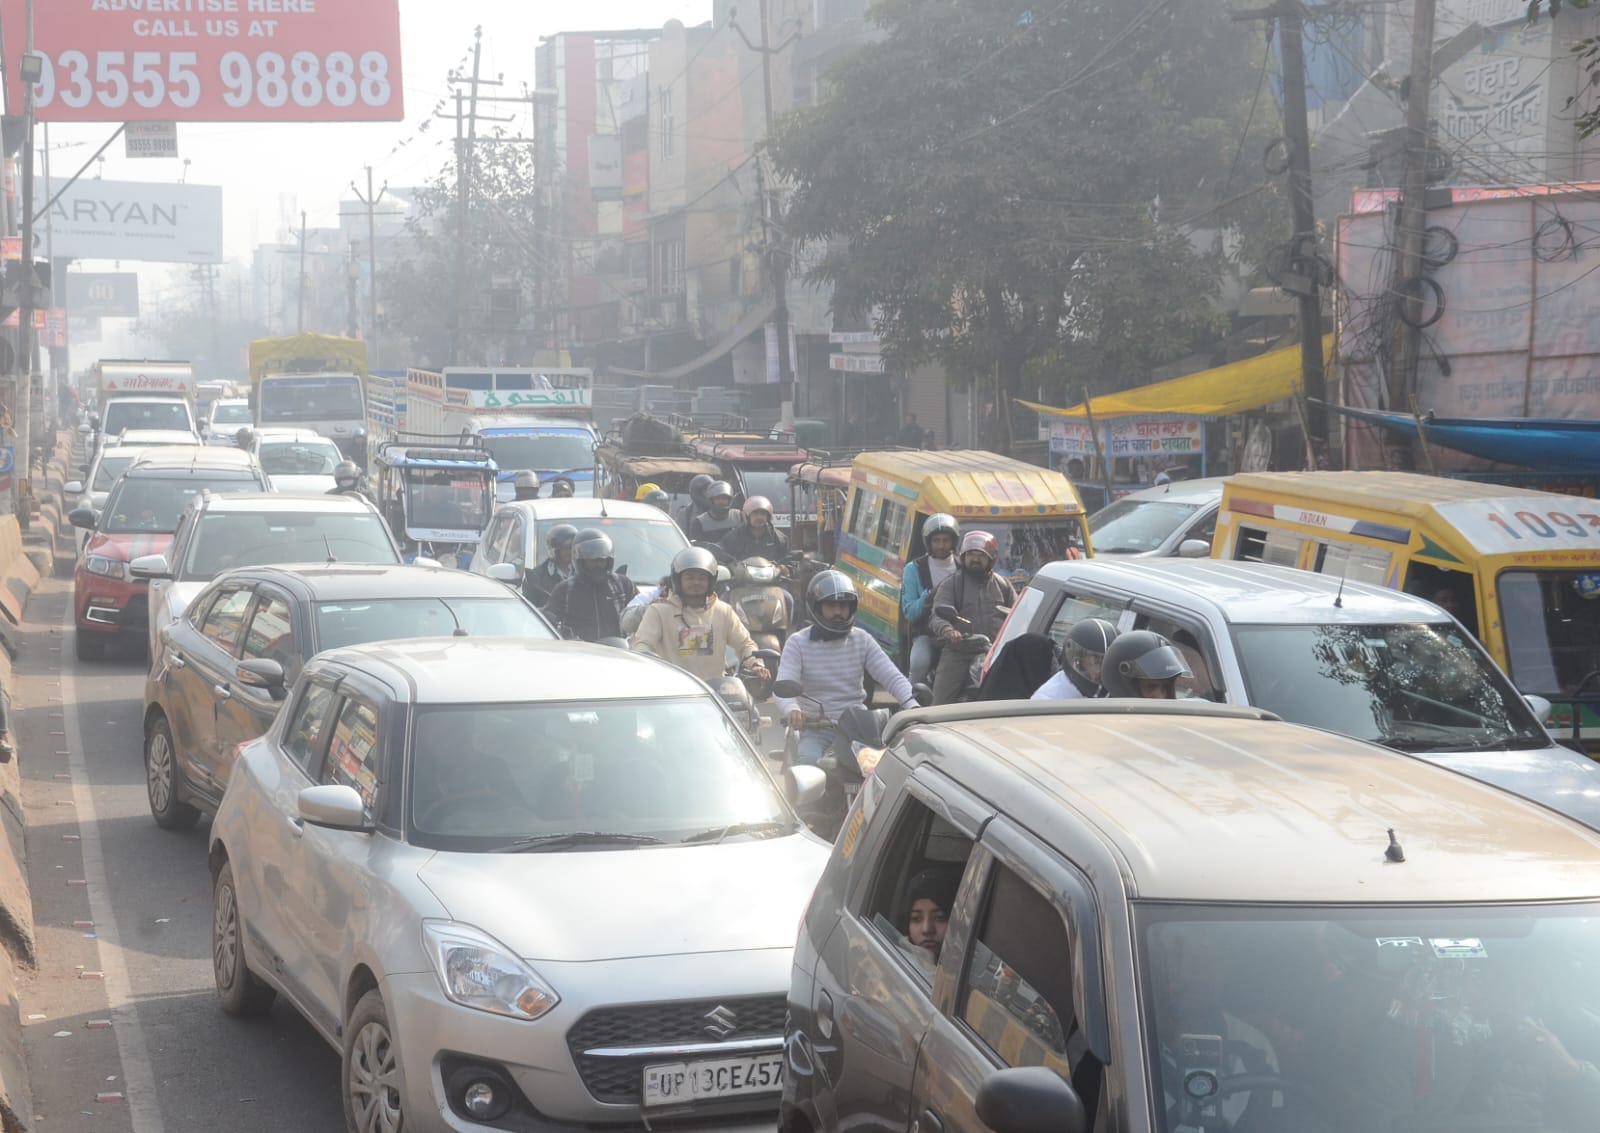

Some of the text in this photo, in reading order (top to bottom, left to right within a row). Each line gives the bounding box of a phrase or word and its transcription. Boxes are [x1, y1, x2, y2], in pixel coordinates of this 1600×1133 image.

[91, 0, 316, 13] ADVERTISE HERE
[133, 19, 279, 37] CALL US AT
[31, 50, 392, 108] 93555 98888
[1299, 511, 1328, 527] INDIAN
